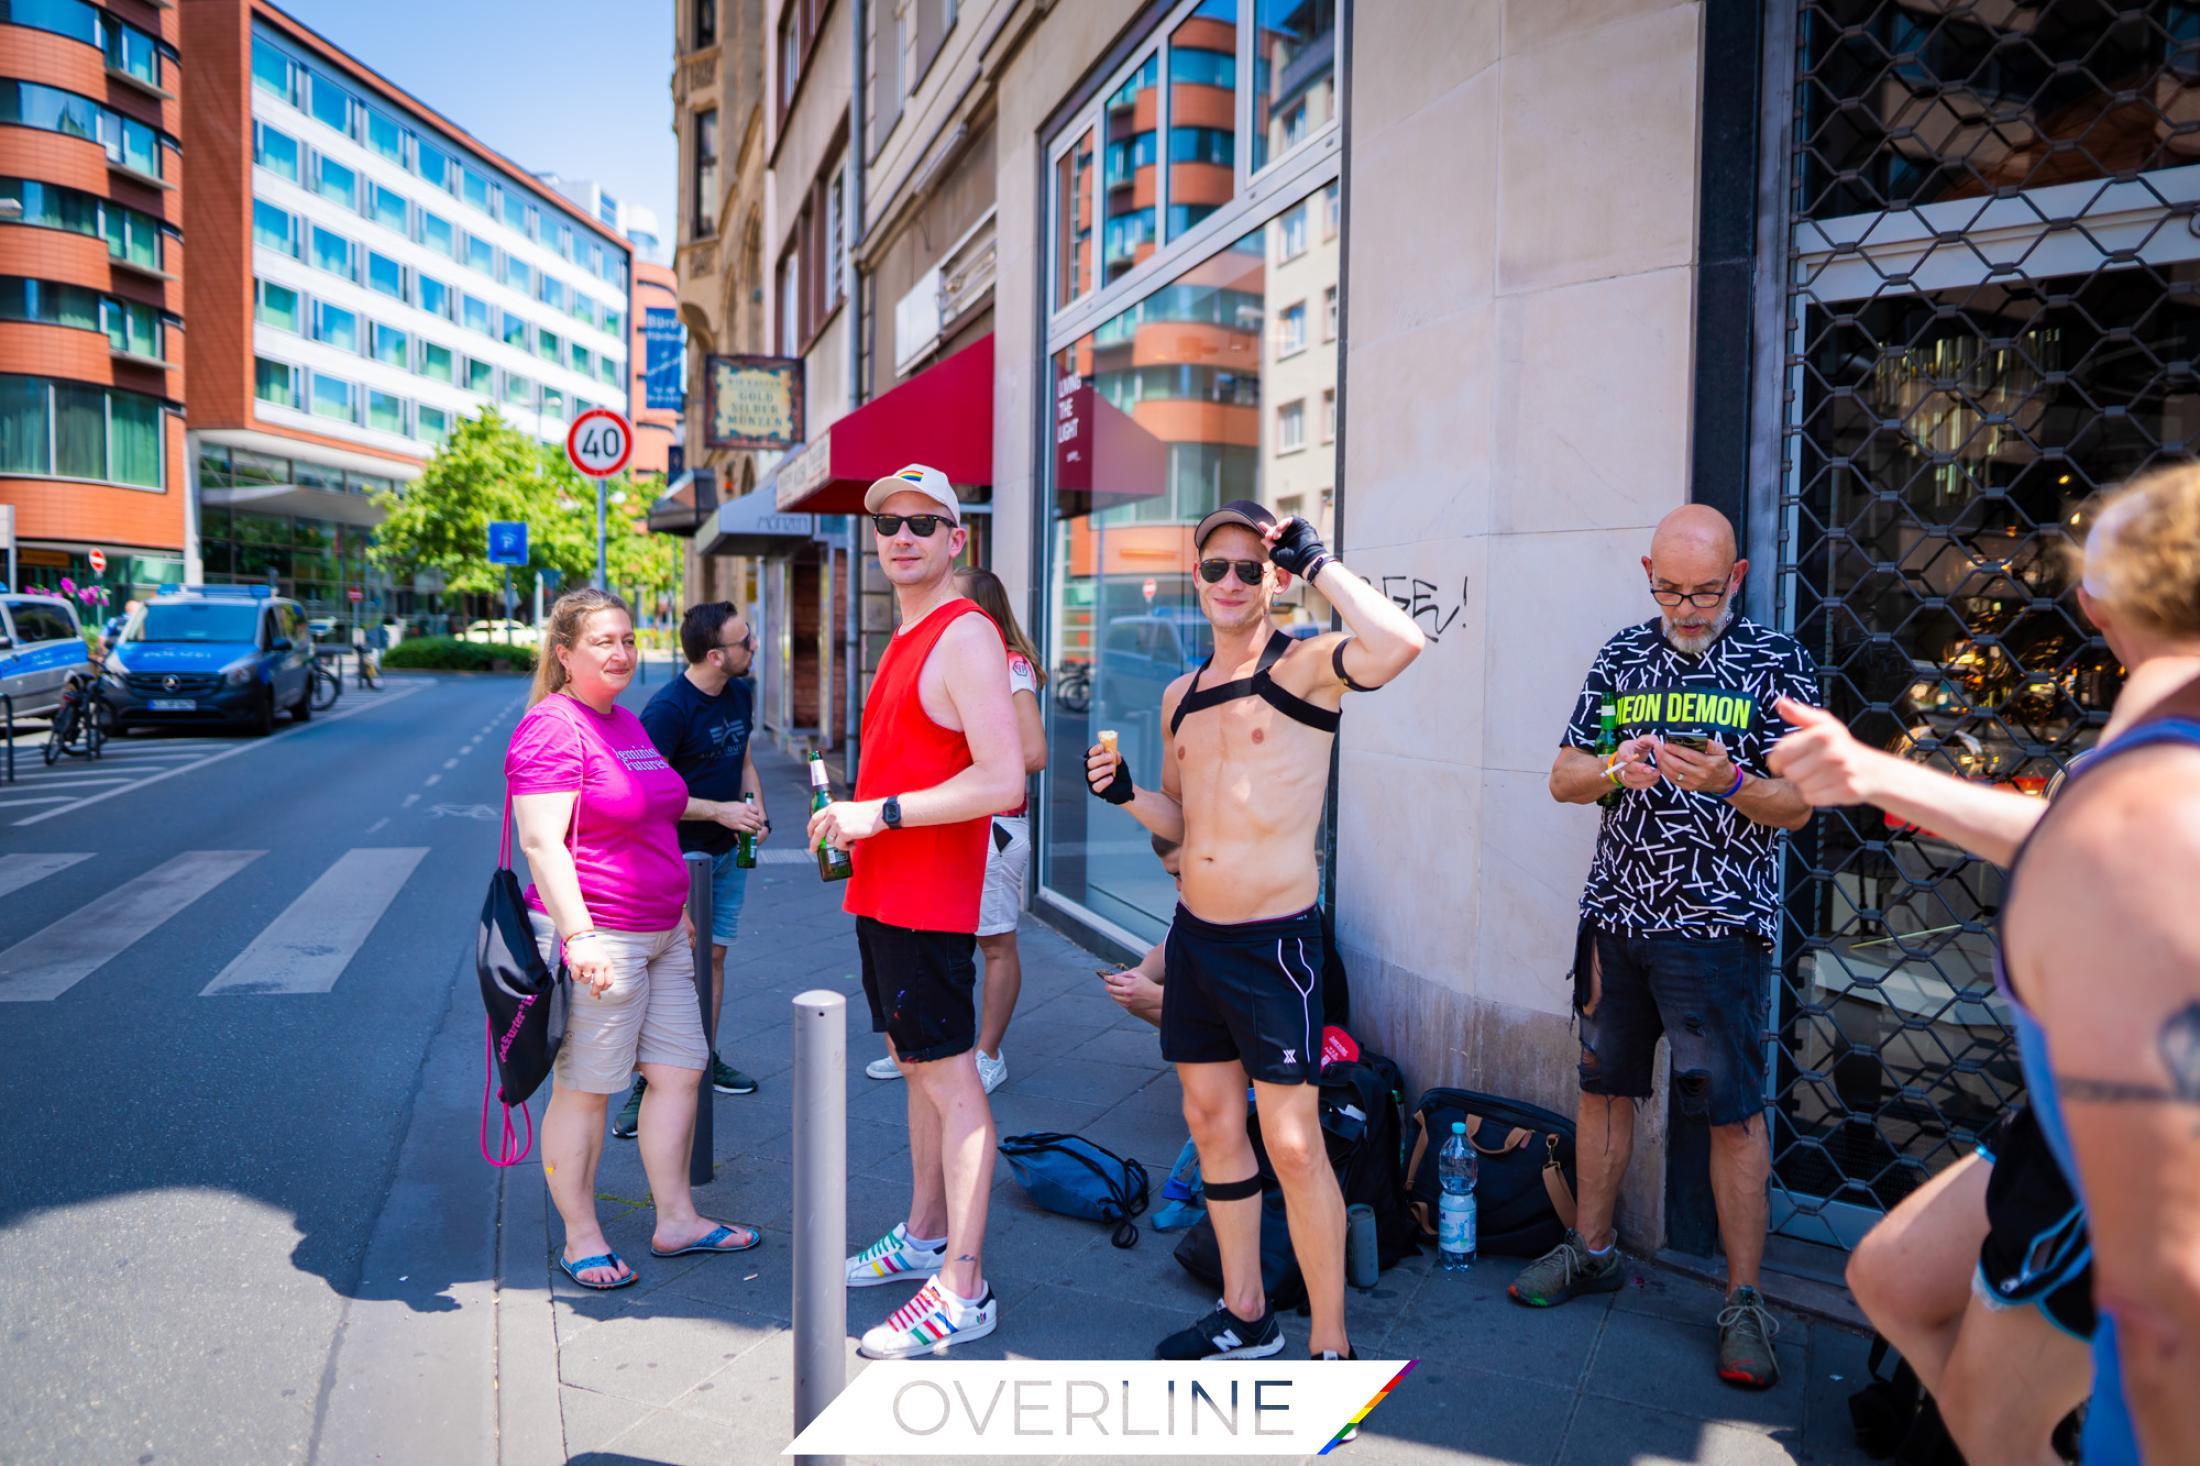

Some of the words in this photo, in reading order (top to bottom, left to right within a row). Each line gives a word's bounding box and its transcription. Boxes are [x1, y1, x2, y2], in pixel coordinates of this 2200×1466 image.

[1058, 397, 1073, 420] THE
[582, 428, 620, 458] 40
[1057, 417, 1079, 444] LIGHT
[1666, 692, 1752, 730] DEMON
